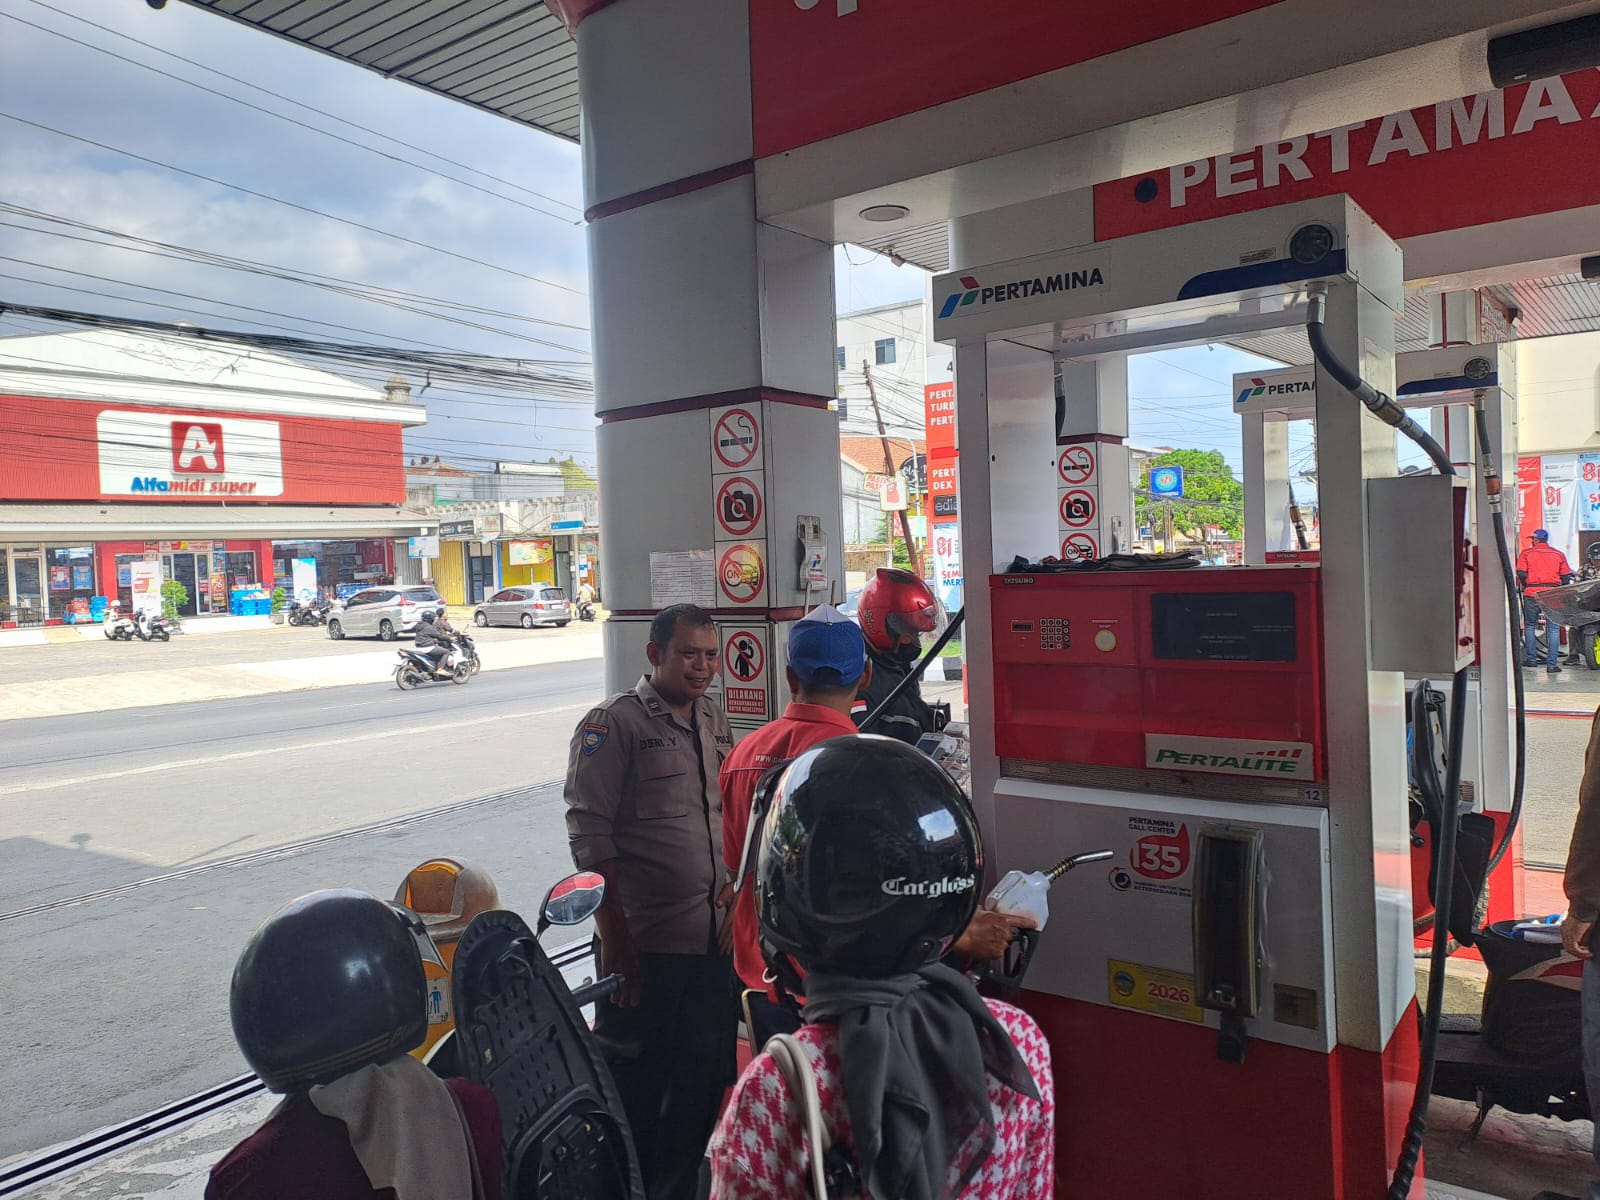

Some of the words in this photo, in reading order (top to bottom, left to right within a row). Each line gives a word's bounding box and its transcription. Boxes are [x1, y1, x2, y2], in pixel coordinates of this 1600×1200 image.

[981, 268, 1104, 304] PERTAMINA
[930, 389, 954, 399] PERT
[930, 415, 955, 426] PERT
[130, 477, 205, 493] Alfamidi
[209, 480, 257, 494] super
[933, 481, 953, 490] DEX
[1545, 486, 1562, 506] 81
[936, 536, 952, 557] 81
[727, 689, 764, 700] DILARANG
[1156, 749, 1299, 773] PERTALITE
[1305, 790, 1320, 801] 12
[1128, 816, 1176, 828] PERTAMINA
[1128, 823, 1146, 832] CALL
[1148, 826, 1176, 834] CENTER
[1132, 842, 1181, 873] 135
[1147, 982, 1190, 1003] 2026
